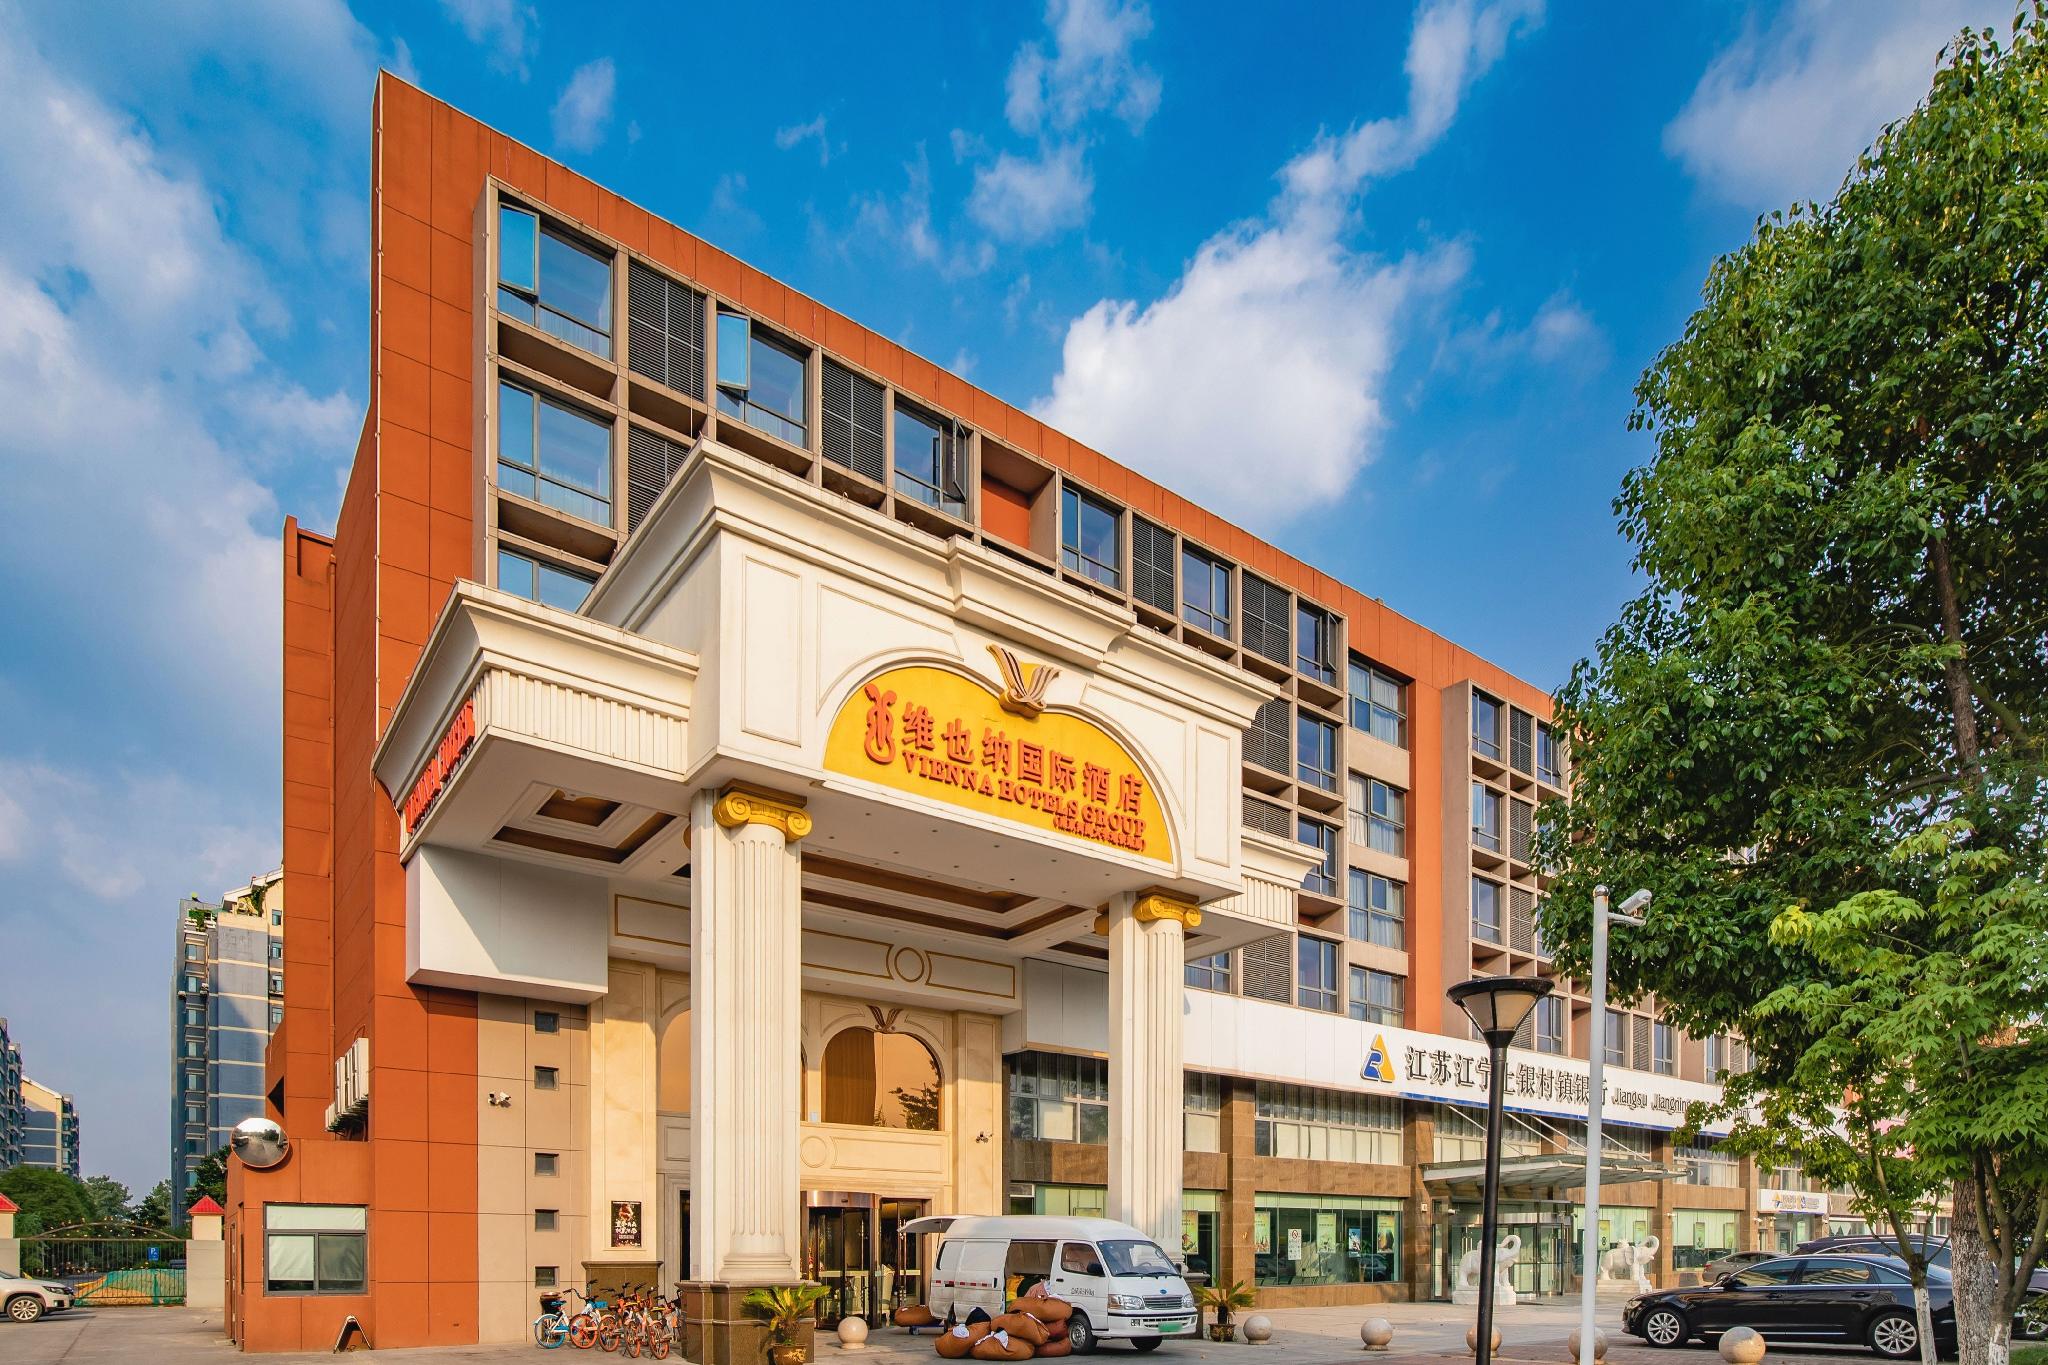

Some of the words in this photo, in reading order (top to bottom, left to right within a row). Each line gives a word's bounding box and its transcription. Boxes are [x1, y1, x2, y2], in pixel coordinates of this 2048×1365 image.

[902, 702, 1143, 814] 维也纳国际酒店
[902, 751, 993, 796] VIENNA
[998, 779, 1078, 819] HOTELS
[1081, 805, 1146, 837] GROUP
[1612, 1088, 1648, 1110] Jiangsu
